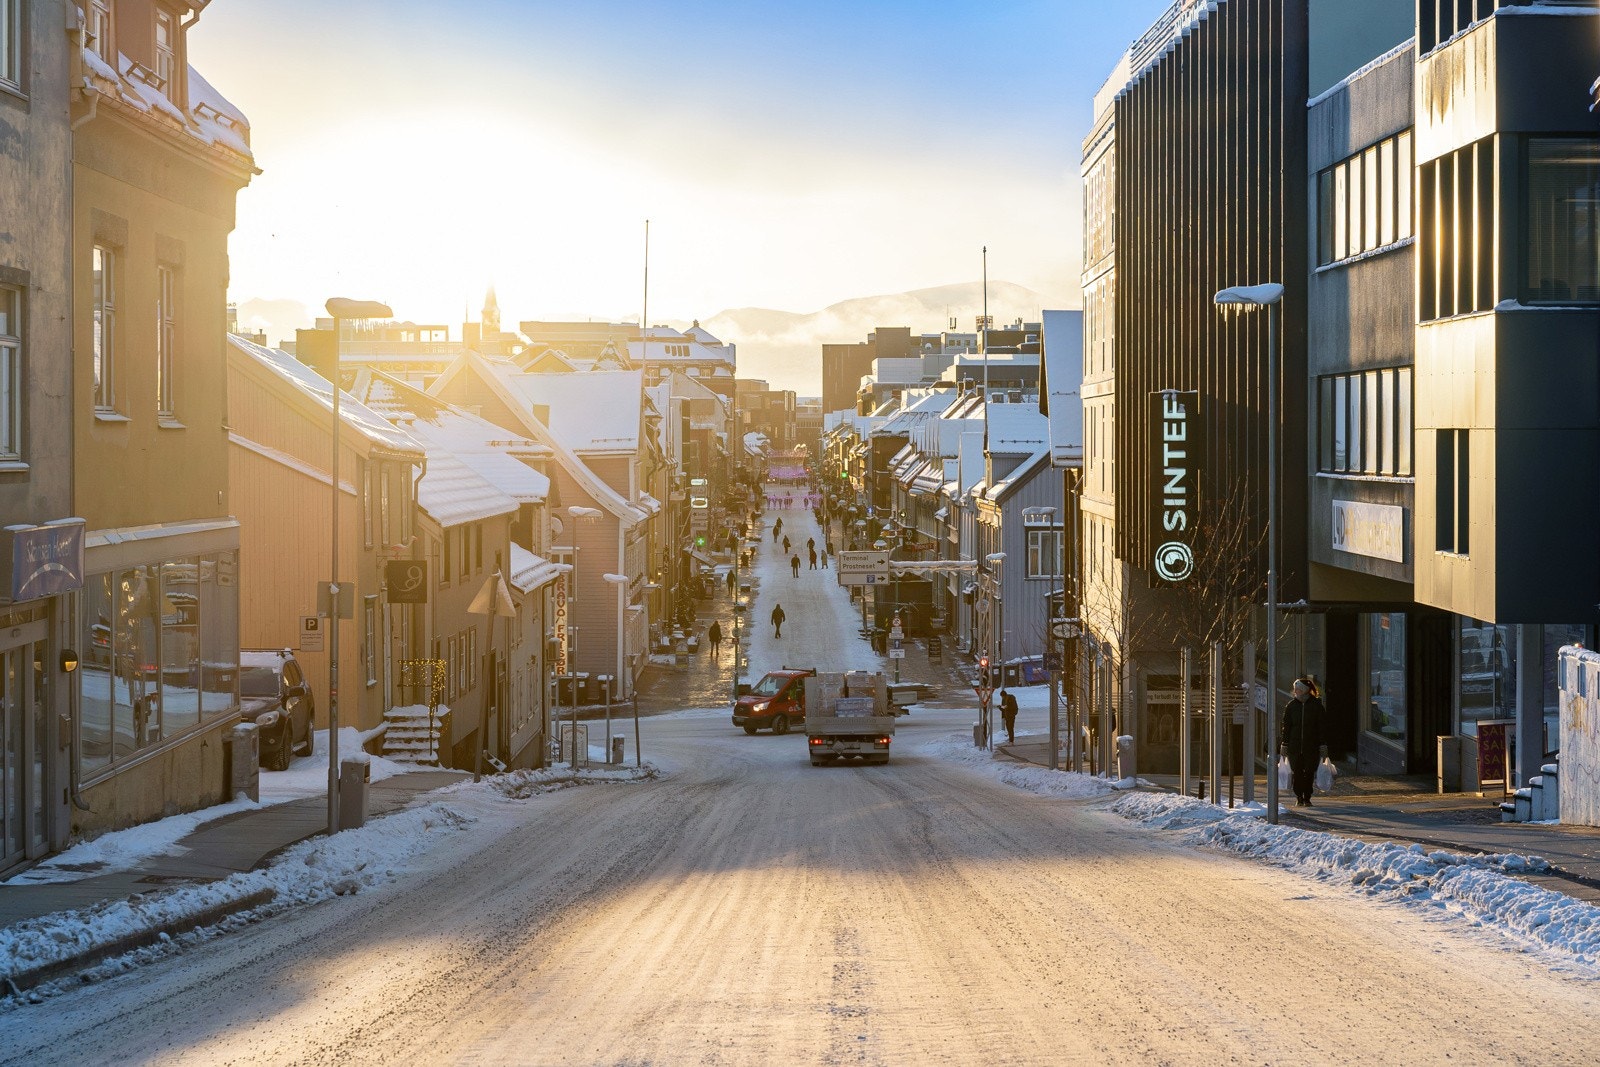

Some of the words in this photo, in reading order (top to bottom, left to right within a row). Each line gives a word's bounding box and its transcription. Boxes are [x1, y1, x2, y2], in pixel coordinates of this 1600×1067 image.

[1163, 397, 1187, 531] SINTEF
[556, 574, 566, 617] BRAVO
[308, 619, 316, 629] P
